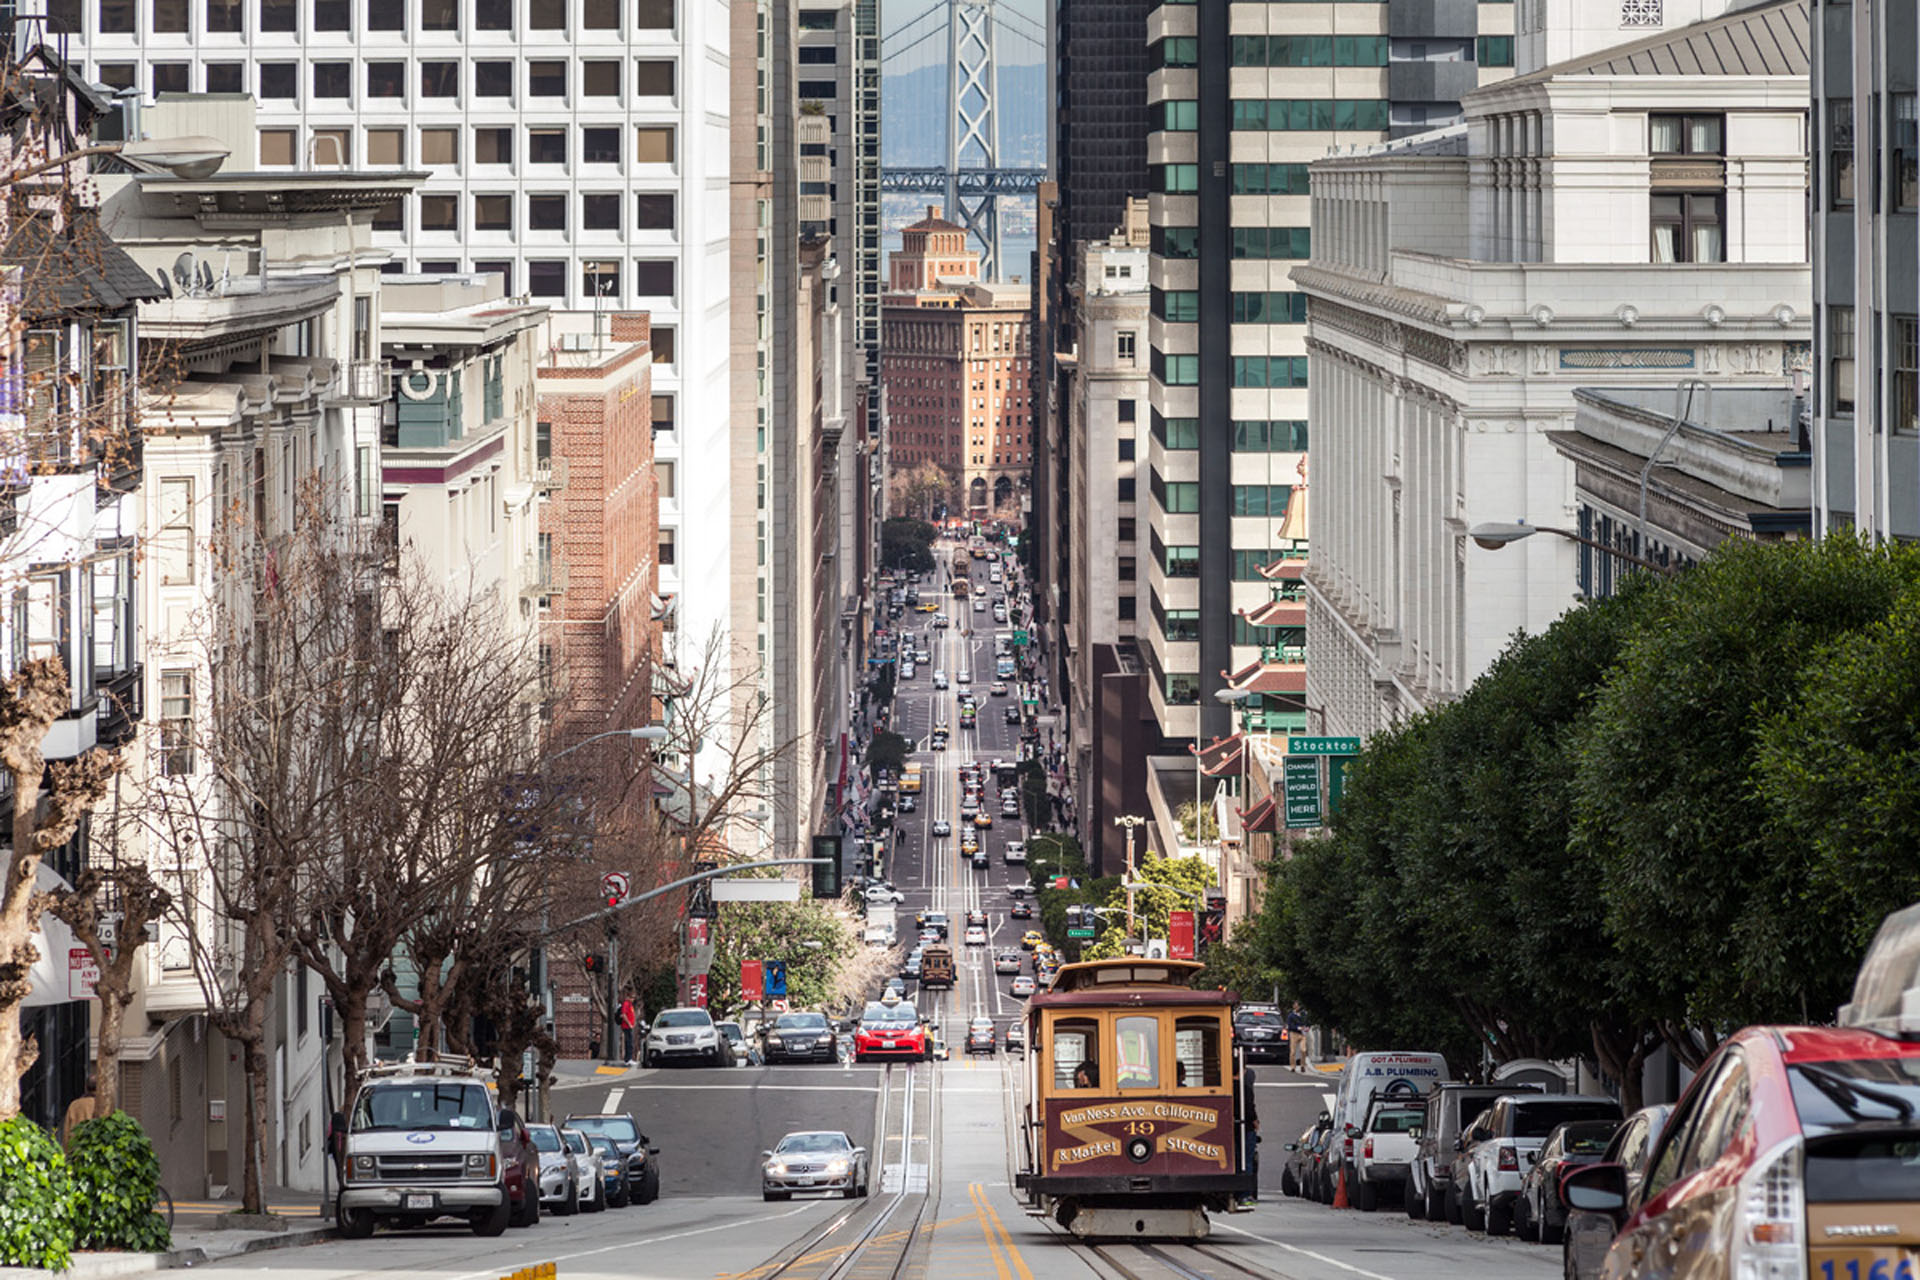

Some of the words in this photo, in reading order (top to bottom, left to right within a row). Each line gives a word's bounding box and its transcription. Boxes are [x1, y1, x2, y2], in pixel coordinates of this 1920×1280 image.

[1287, 762, 1315, 770] CHANGE
[1289, 783, 1316, 791] WORLD
[1290, 804, 1316, 814] HERE
[81, 970, 98, 979] ANY
[1387, 1067, 1439, 1077] PLUMBING
[1063, 1111, 1086, 1124] Van
[1086, 1105, 1117, 1119] Ness
[1154, 1103, 1217, 1123] California
[1123, 1120, 1156, 1136] 49
[1059, 1149, 1068, 1161] &
[1070, 1140, 1117, 1161] Market
[1166, 1137, 1219, 1157] Streets
[1820, 1257, 1915, 1280] 1166
